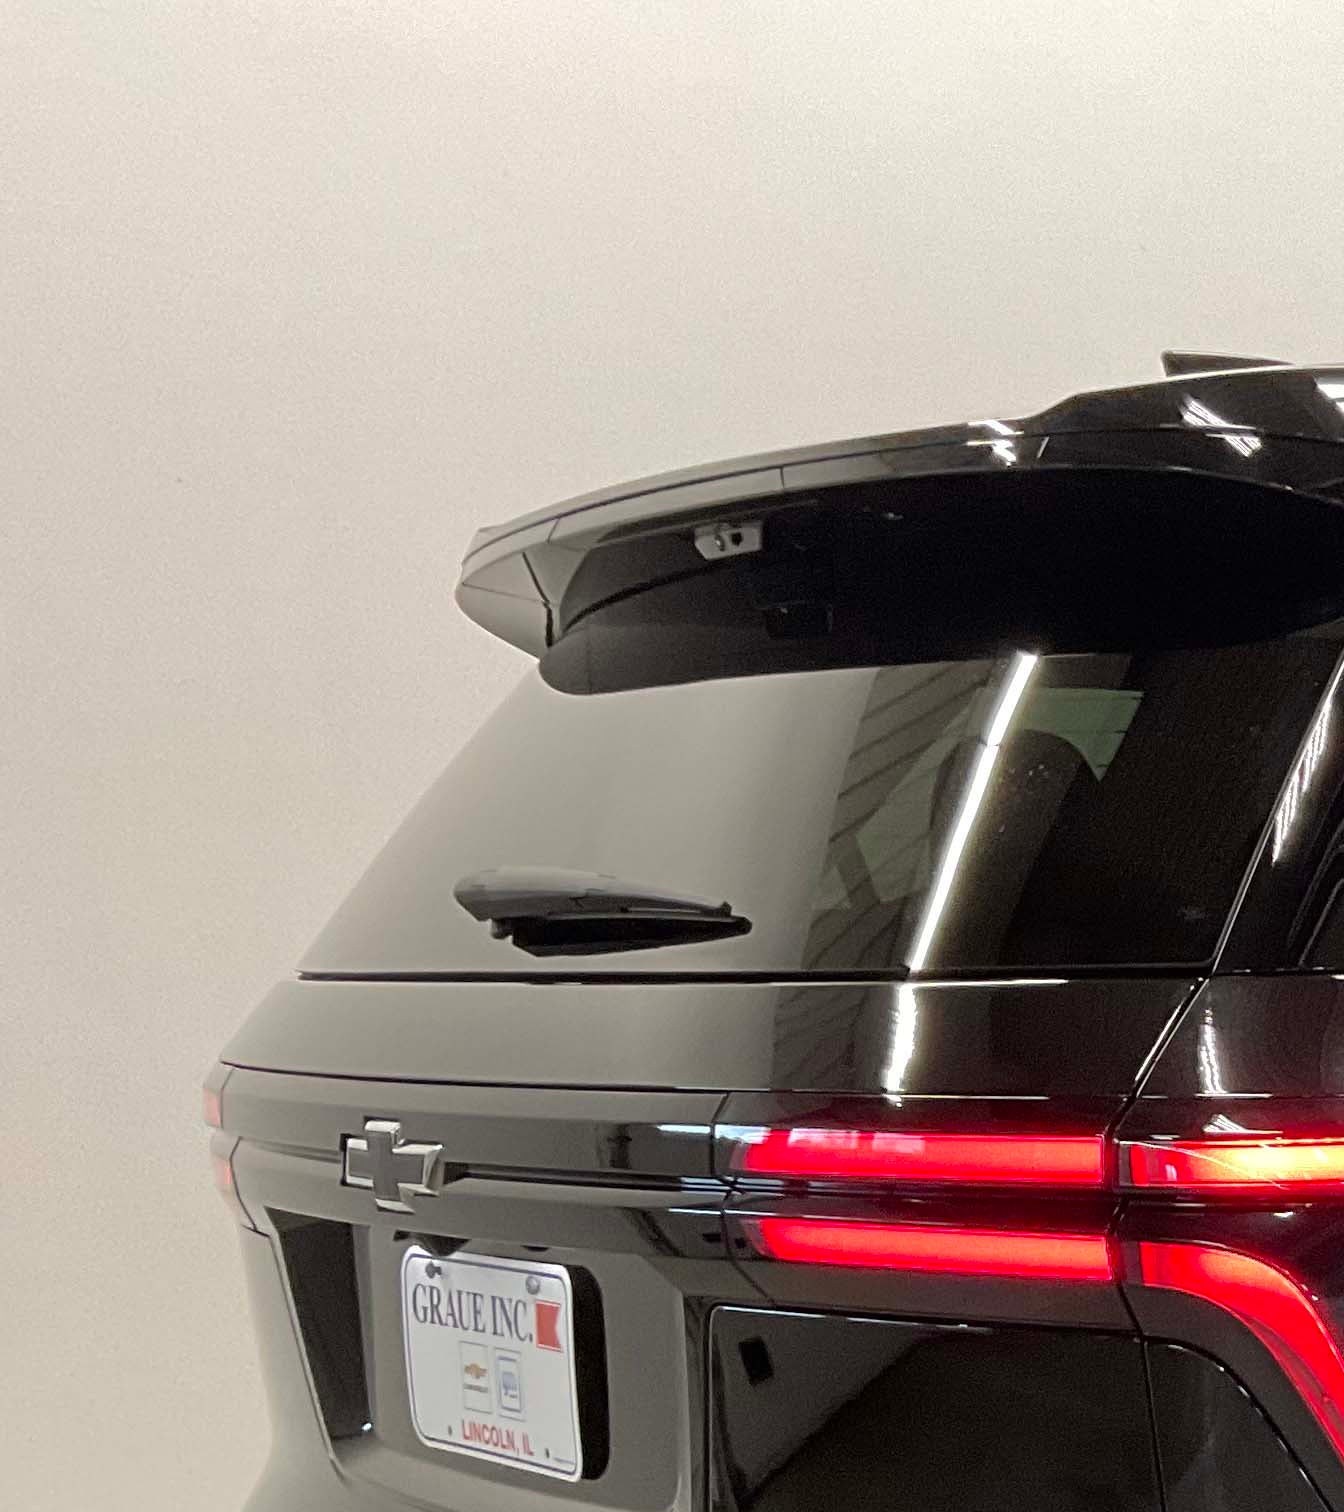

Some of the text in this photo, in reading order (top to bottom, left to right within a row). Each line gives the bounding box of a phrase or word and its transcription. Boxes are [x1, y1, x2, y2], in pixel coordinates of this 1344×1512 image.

[412, 1282, 534, 1343] GRAUE INC.
[461, 1419, 535, 1457] LINCOLN, IL
